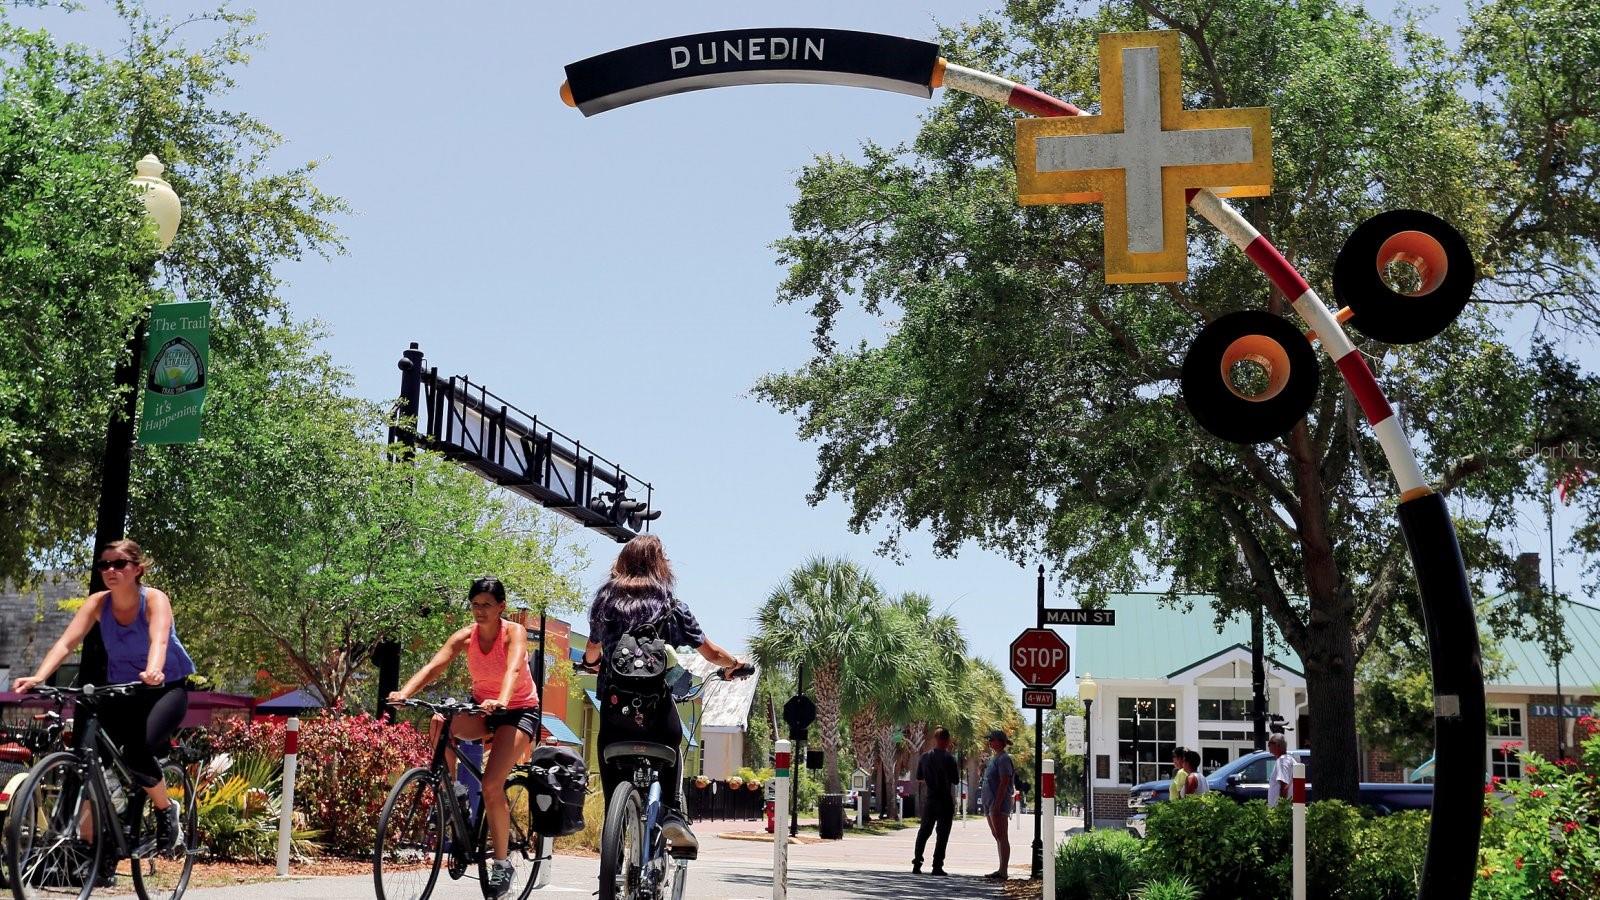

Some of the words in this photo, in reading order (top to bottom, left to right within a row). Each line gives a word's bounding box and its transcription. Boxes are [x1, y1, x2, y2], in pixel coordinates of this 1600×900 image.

[670, 37, 825, 70] DUNEDIN
[153, 318, 177, 331] The
[179, 316, 206, 330] Trail
[155, 400, 172, 417] it's
[145, 405, 198, 431] Happening
[1047, 611, 1087, 623] MAIN
[1093, 612, 1113, 623] ST
[1016, 647, 1064, 668] STOP
[1028, 694, 1051, 703] 4-WAY
